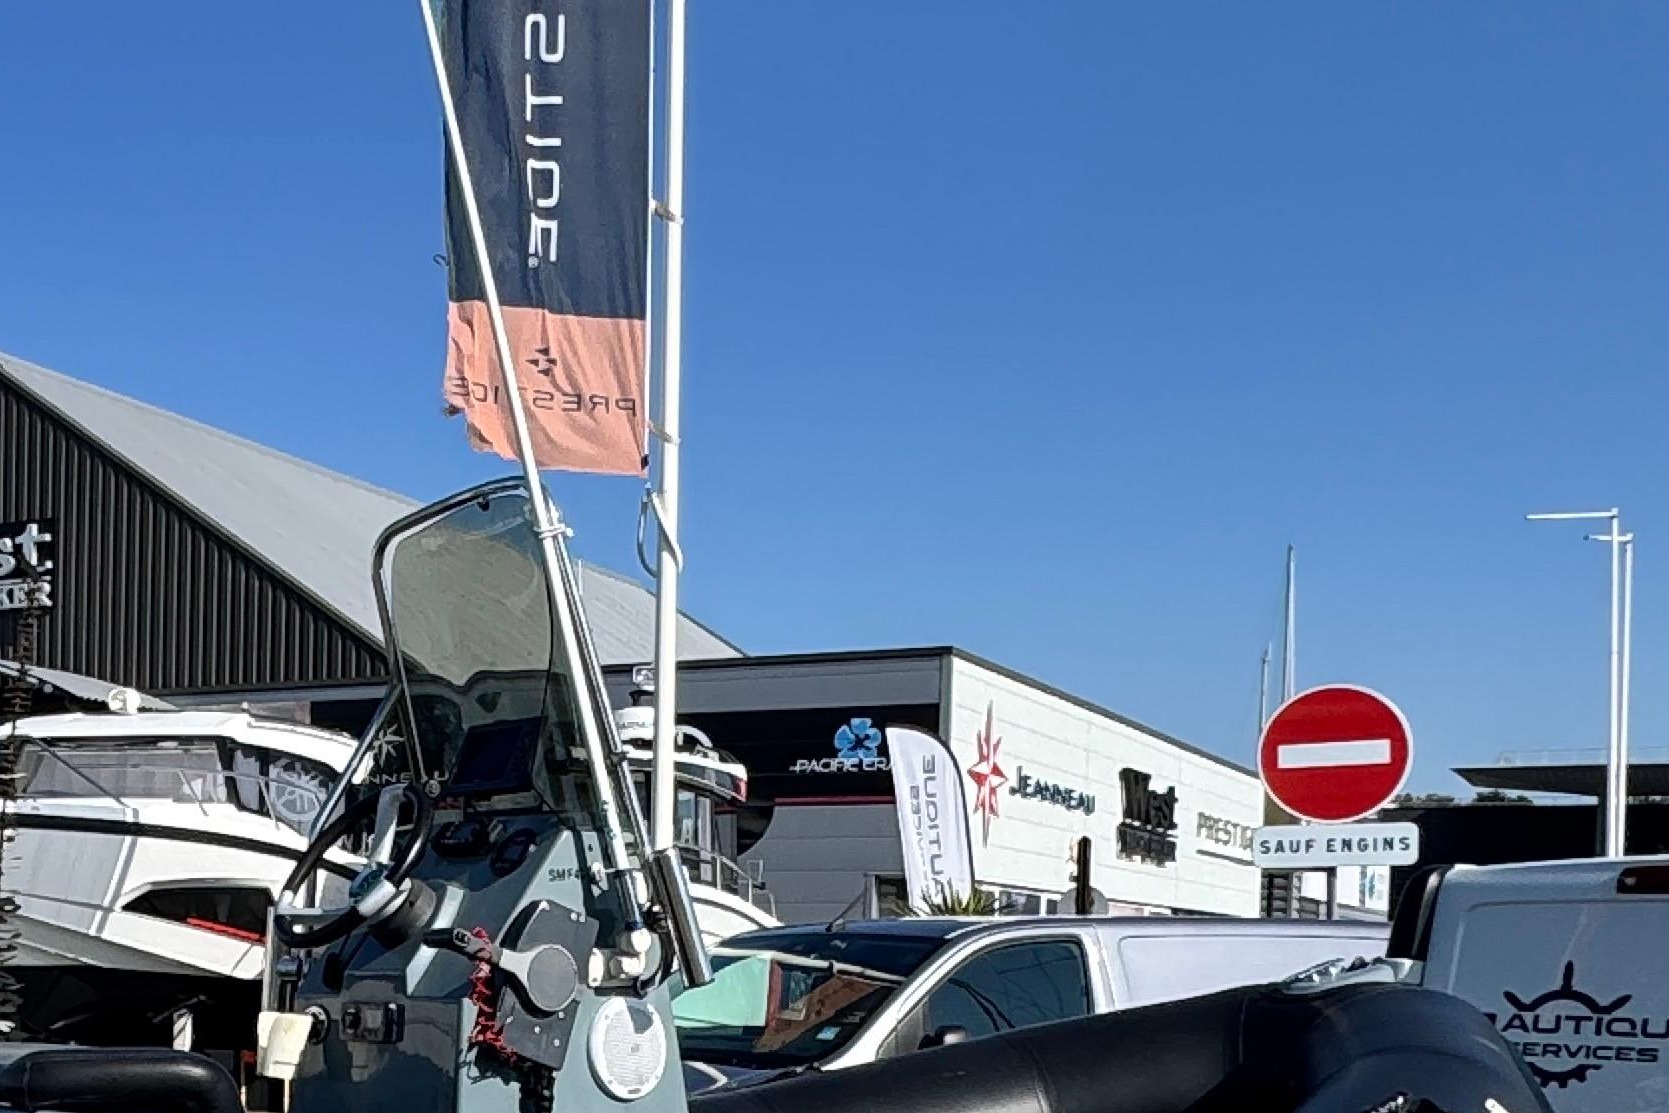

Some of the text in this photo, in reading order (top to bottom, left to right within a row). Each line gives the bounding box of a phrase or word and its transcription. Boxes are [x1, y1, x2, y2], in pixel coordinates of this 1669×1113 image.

[789, 757, 860, 774] PACIFIC
[1009, 765, 1096, 817] JEANNEAU
[1258, 836, 1412, 855] SAUF ENGINS
[1482, 1011, 1669, 1040] AUTIQU
[1512, 1041, 1660, 1063] ERVICES
